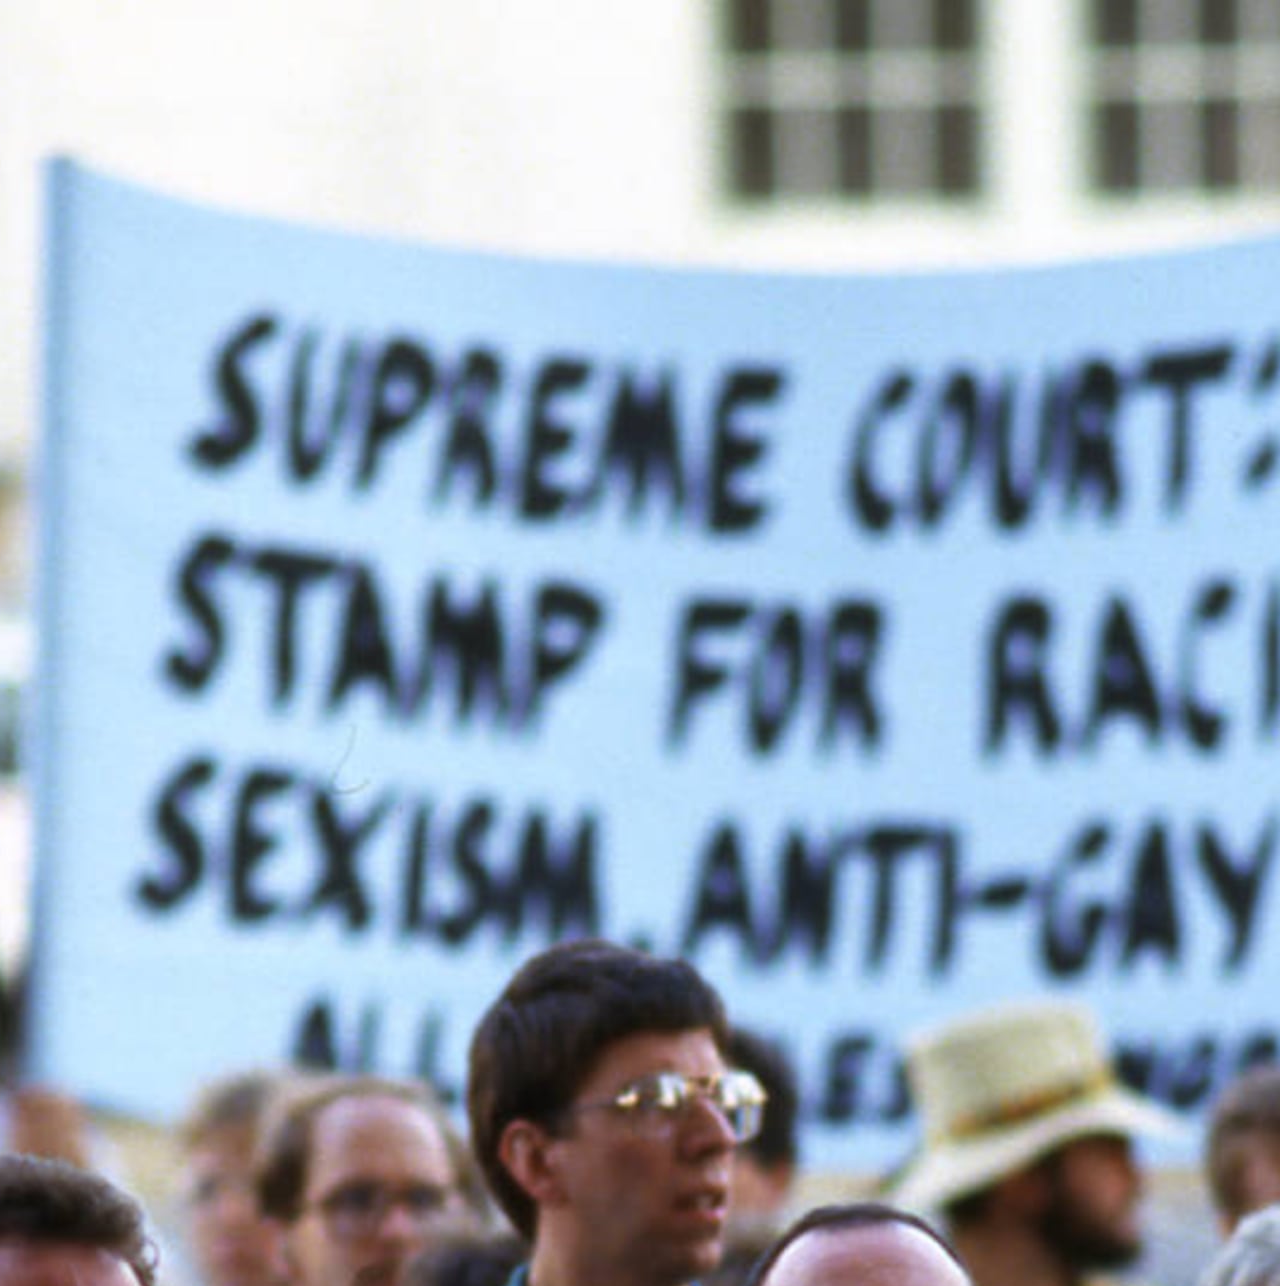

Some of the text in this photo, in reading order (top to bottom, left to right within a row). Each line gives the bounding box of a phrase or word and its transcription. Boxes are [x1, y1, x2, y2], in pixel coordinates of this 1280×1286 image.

[185, 309, 789, 535] SUPREME
[159, 529, 609, 739] STAMP
[666, 594, 886, 759] FOR
[682, 812, 1279, 985] ANTI-GAY
